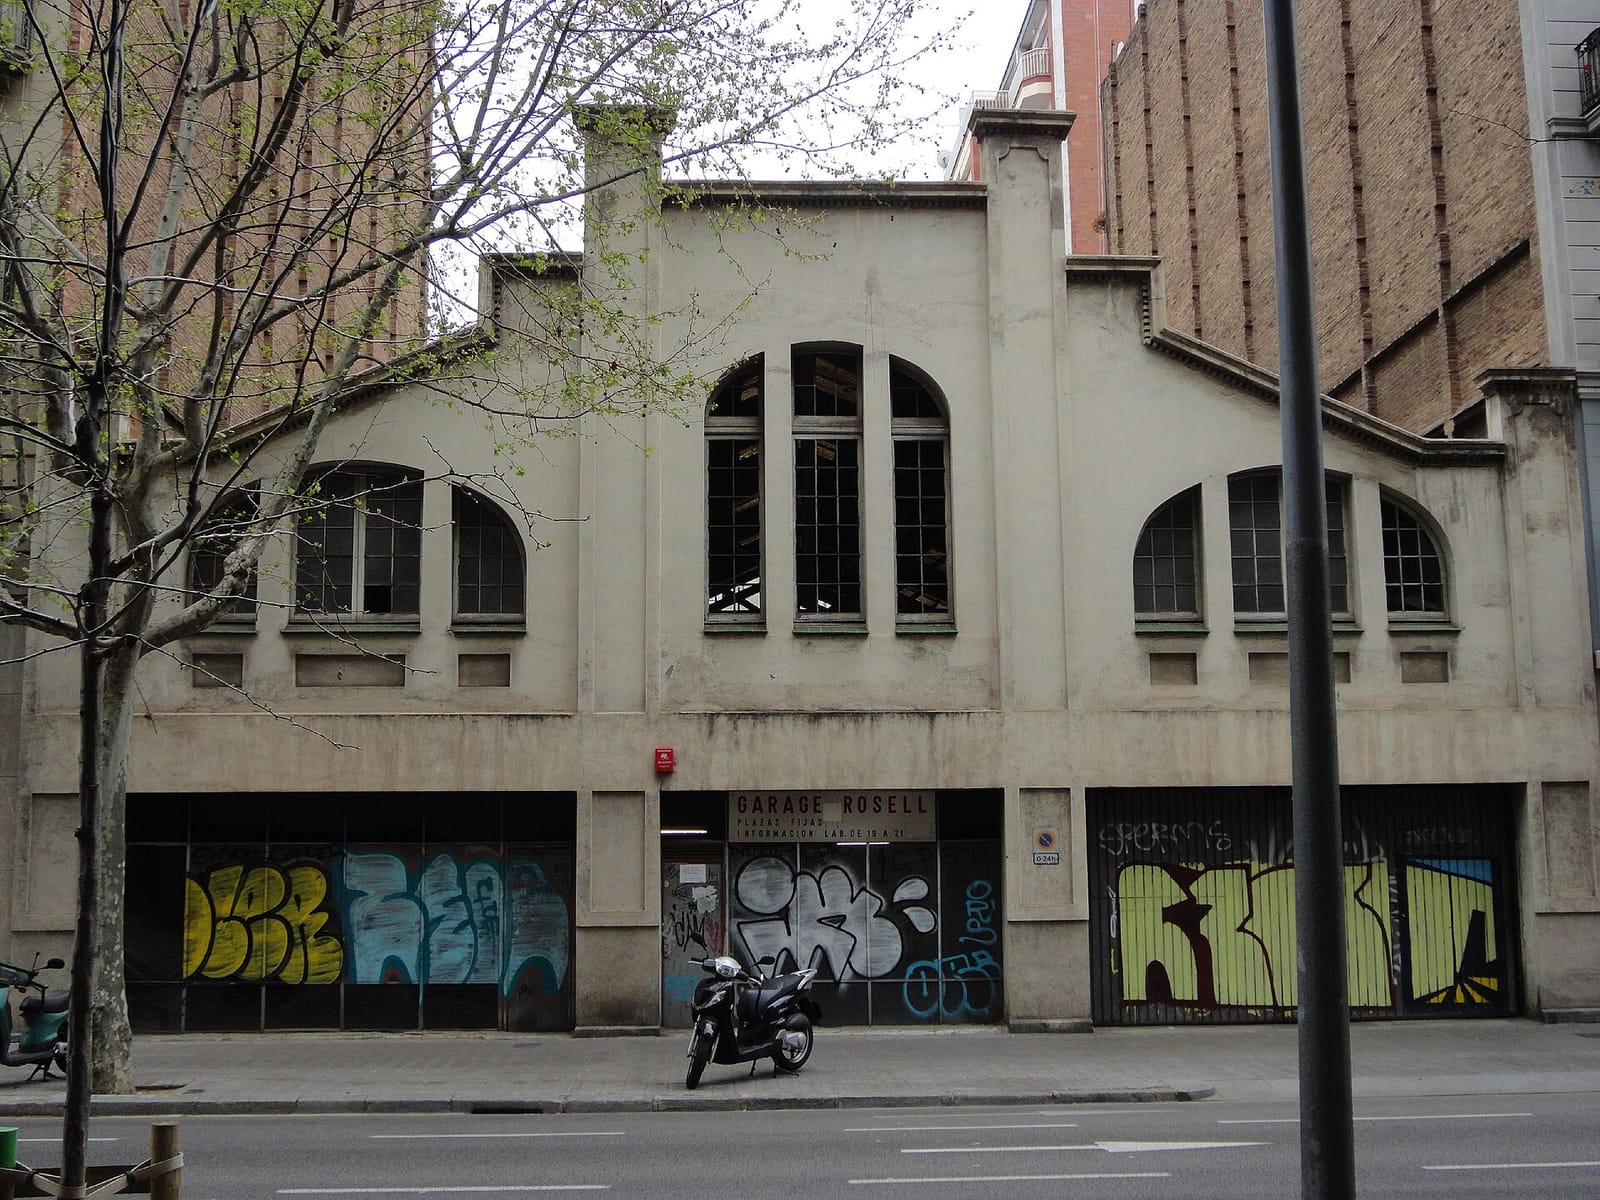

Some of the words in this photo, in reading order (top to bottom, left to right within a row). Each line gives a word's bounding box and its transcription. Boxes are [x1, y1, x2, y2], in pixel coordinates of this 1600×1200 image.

[737, 795, 823, 814] GARAGE
[843, 795, 927, 814] ROSELL
[737, 818, 780, 827] PLAZAS
[791, 818, 823, 827] FIJAS
[883, 829, 888, 838] A
[894, 829, 904, 838] 21
